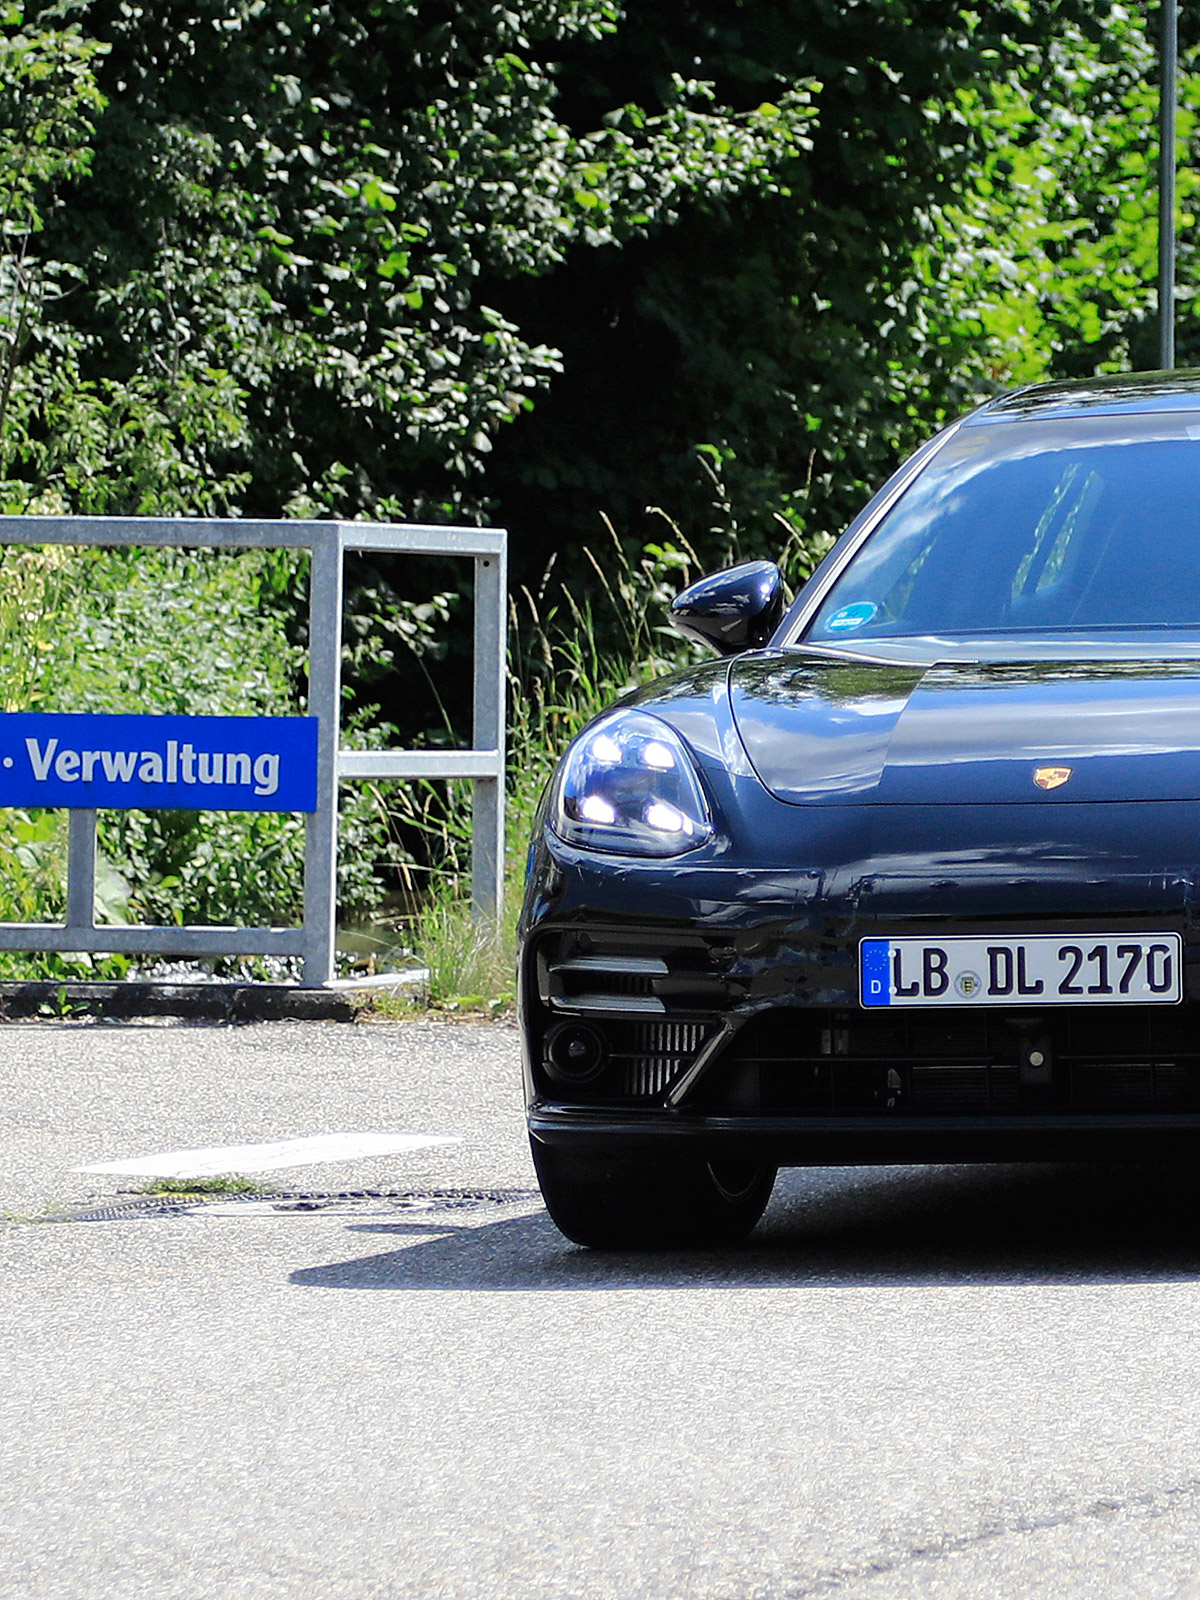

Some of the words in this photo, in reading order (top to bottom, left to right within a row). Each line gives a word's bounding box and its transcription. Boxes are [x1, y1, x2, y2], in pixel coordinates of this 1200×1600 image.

[25, 738, 280, 795] Verwaltung
[871, 980, 881, 994] D
[894, 948, 949, 997] LB
[987, 946, 1044, 995] DL
[1058, 944, 1172, 994] 2170
